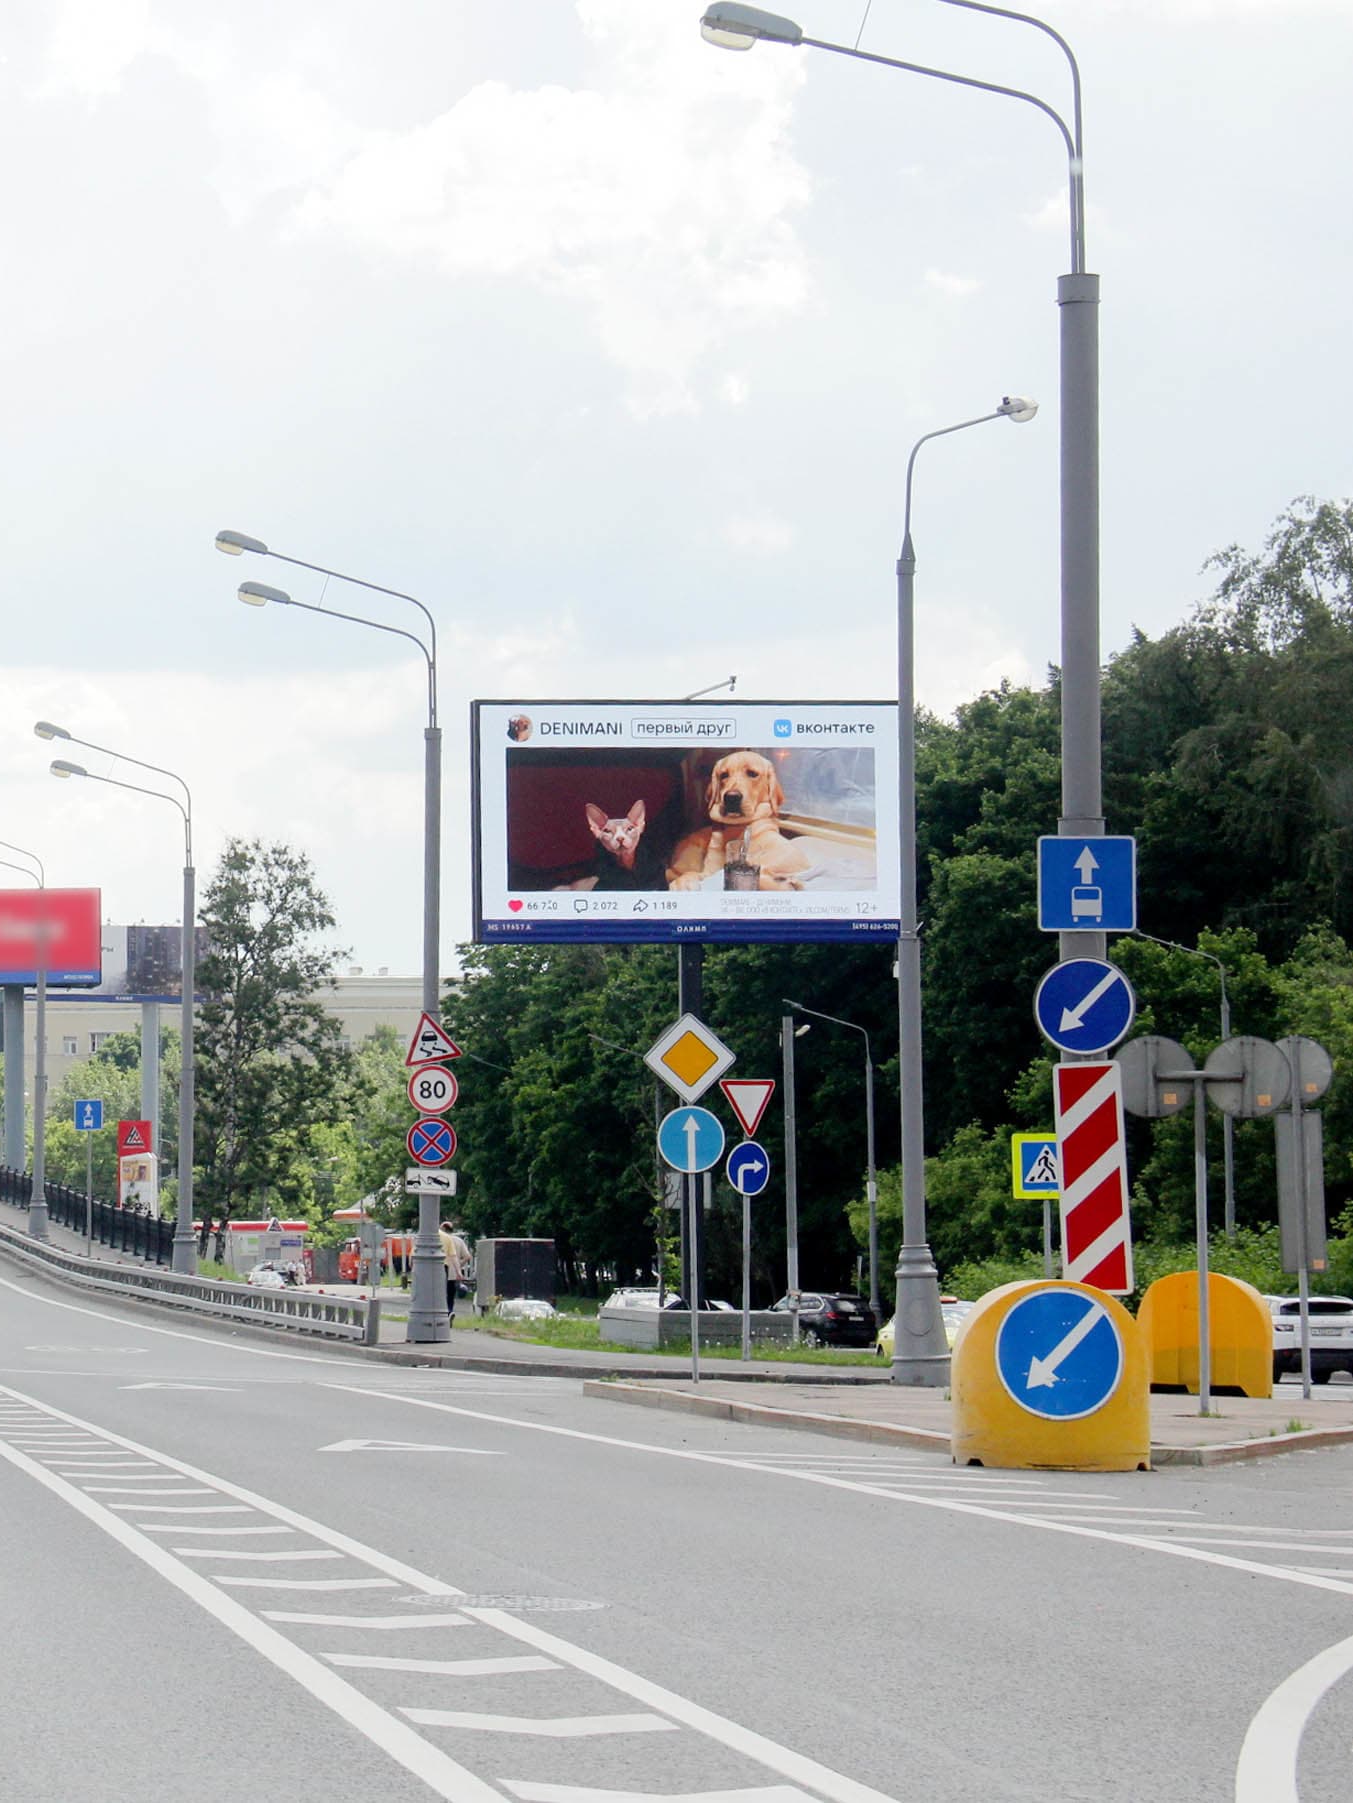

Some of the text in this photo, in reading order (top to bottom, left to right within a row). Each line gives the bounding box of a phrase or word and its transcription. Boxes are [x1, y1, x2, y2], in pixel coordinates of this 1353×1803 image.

[540, 721, 623, 735] DENIMANI
[636, 720, 732, 738] первый друг
[796, 723, 875, 734] вконтакте
[527, 902, 539, 910] 66
[855, 902, 878, 914] 12+
[419, 1080, 446, 1099] 80
